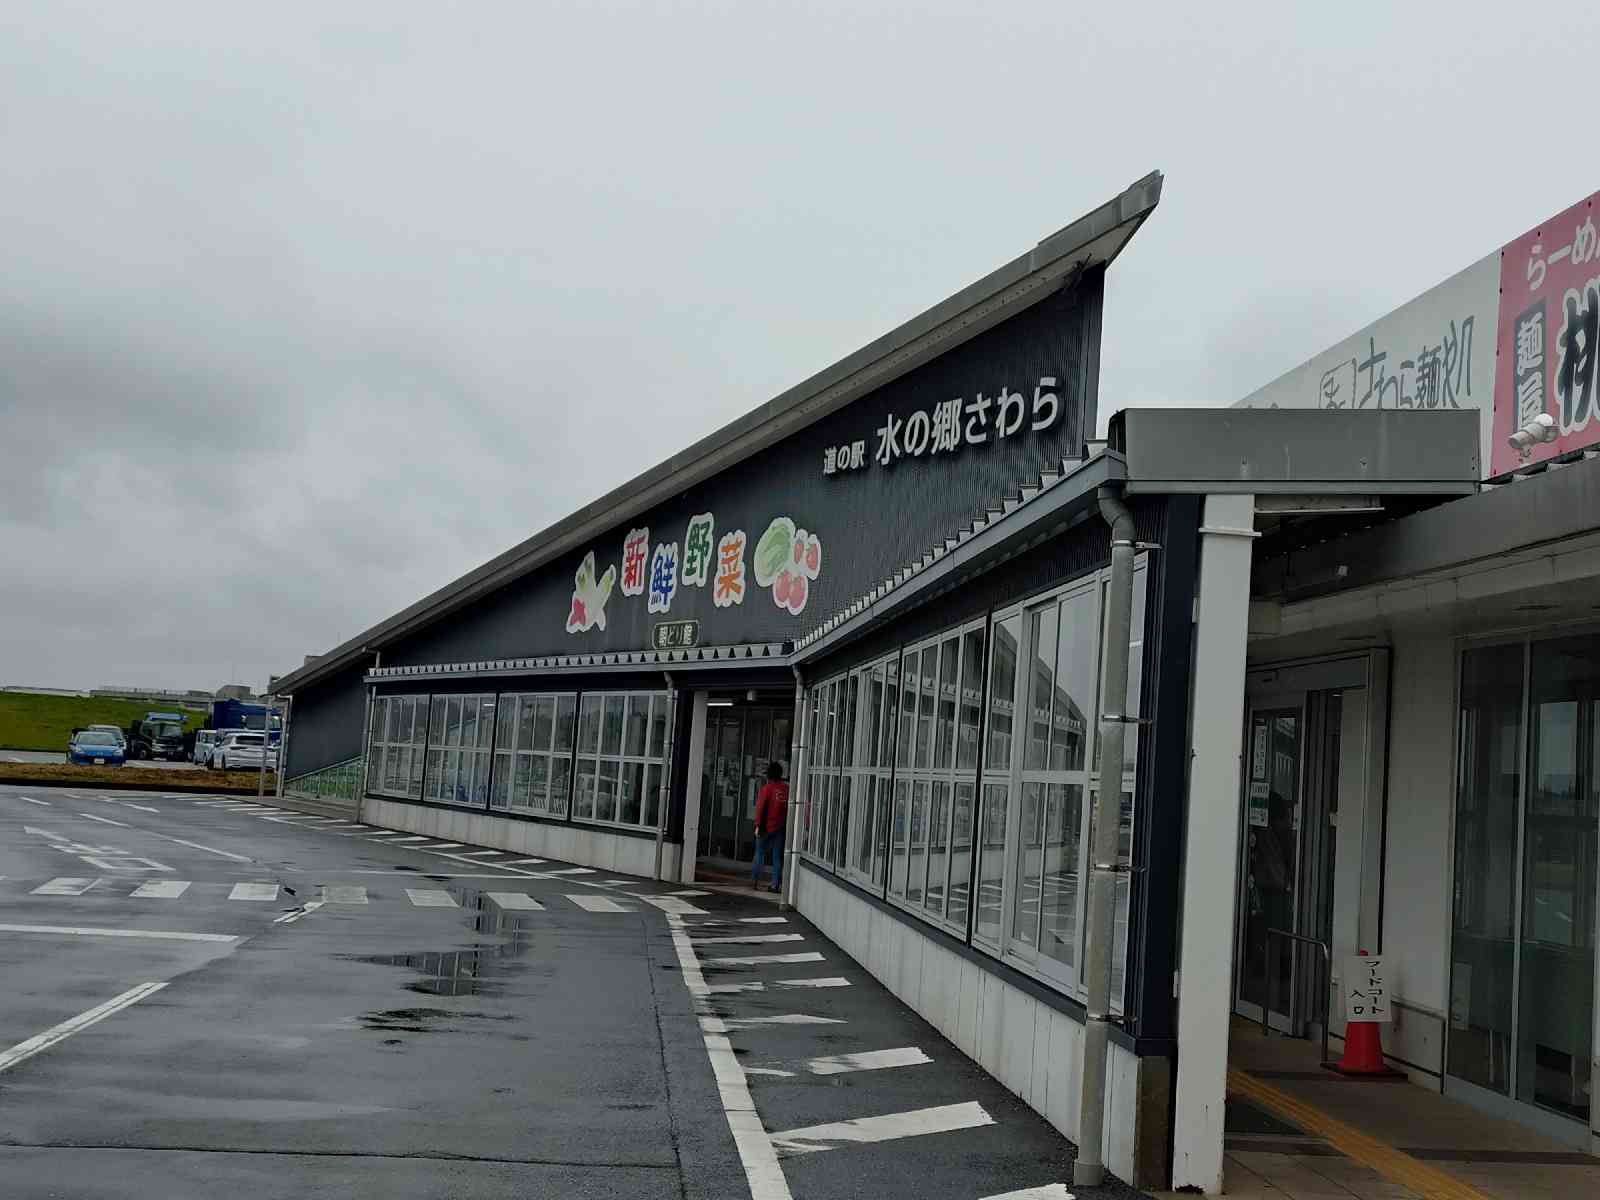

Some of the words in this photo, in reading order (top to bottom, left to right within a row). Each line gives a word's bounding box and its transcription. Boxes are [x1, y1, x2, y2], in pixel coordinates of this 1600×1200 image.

[1527, 216, 1600, 291] らーめ
[823, 439, 865, 474] 道の駅
[875, 376, 1059, 466] 水の郷さわら
[622, 519, 744, 606] 新鮮野菜
[1351, 989, 1365, 1014] 入口
